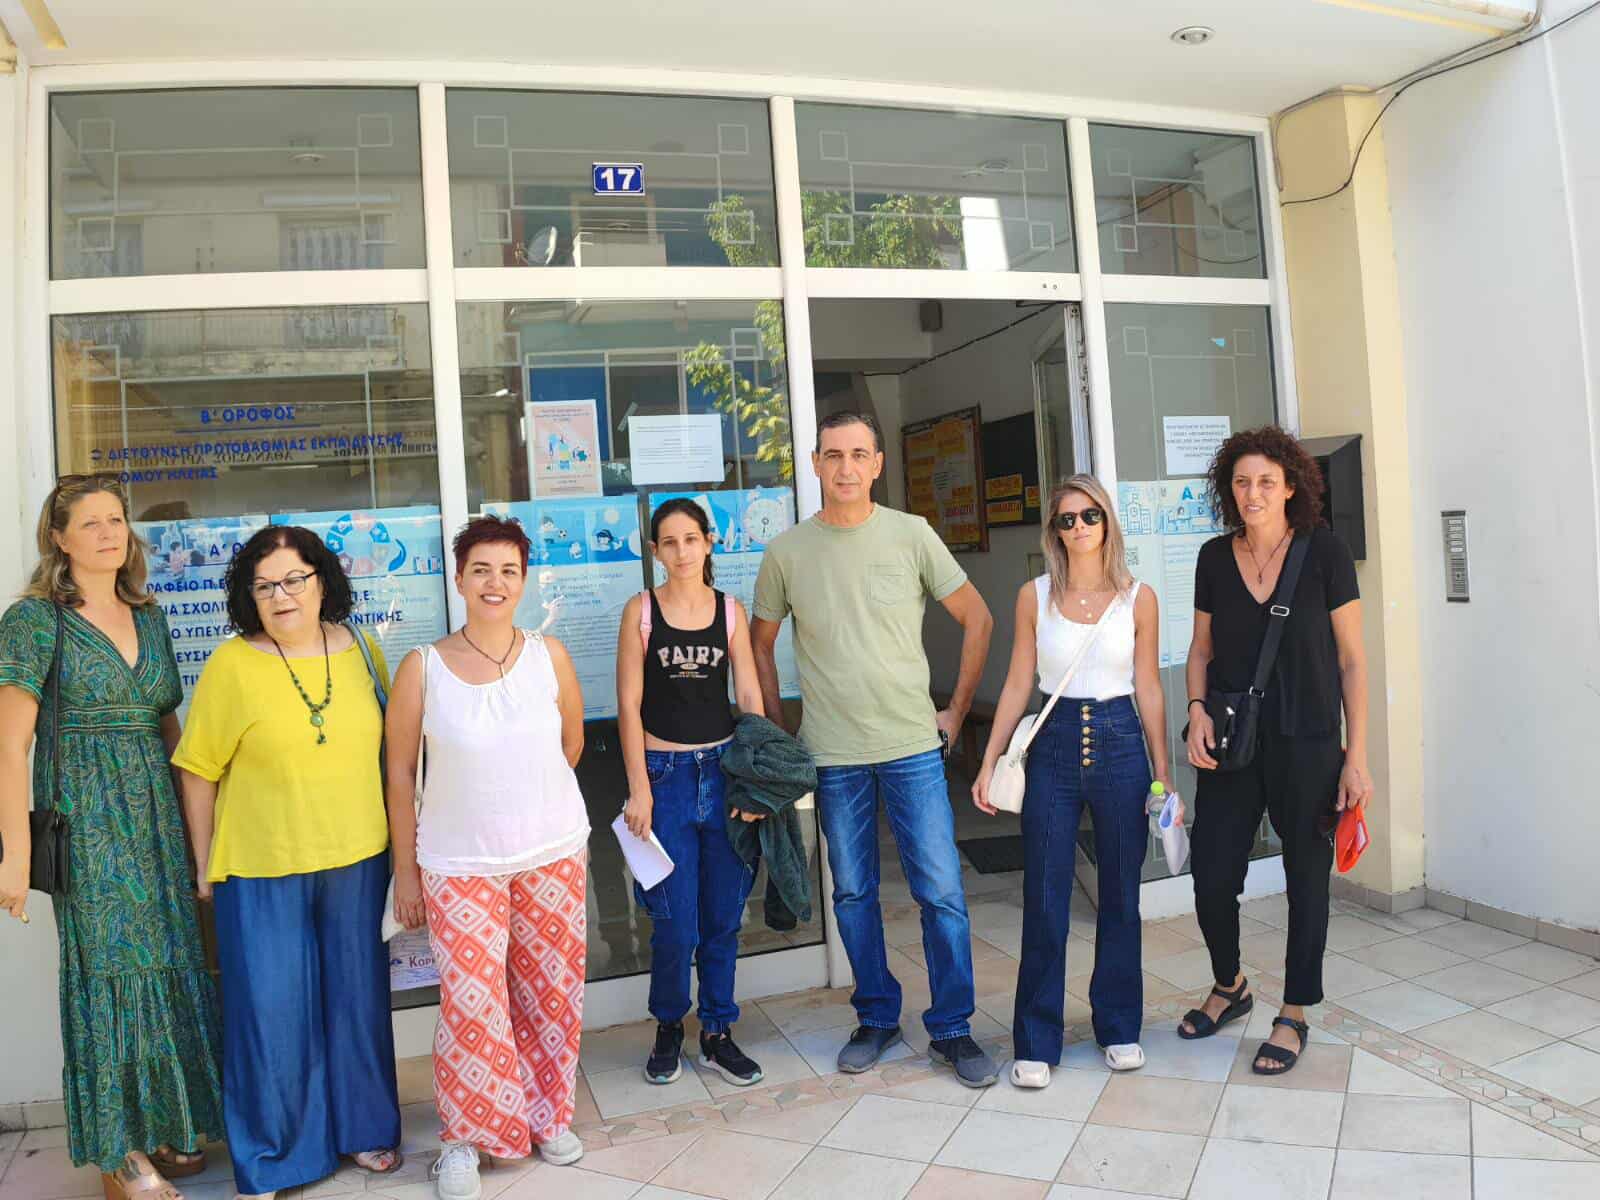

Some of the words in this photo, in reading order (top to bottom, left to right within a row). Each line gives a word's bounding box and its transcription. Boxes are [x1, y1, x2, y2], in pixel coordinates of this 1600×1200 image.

[601, 168, 636, 190] 17
[222, 406, 295, 423] ΟΡΟΦΟΣ
[193, 438, 307, 454] ΠΡΩΤΟΒΑΘΜΙΑΣ
[311, 432, 404, 450] ΕΚΠΑΙΔΕΥΣΗΣ
[119, 469, 162, 484] ΟΜΟΥ
[146, 580, 199, 593] ΡΑΦΕΙΟ
[182, 601, 227, 615] ΣΧΟΛΙ
[185, 623, 237, 639] ΥΠΕΥΘ
[657, 645, 724, 668] FAIRY
